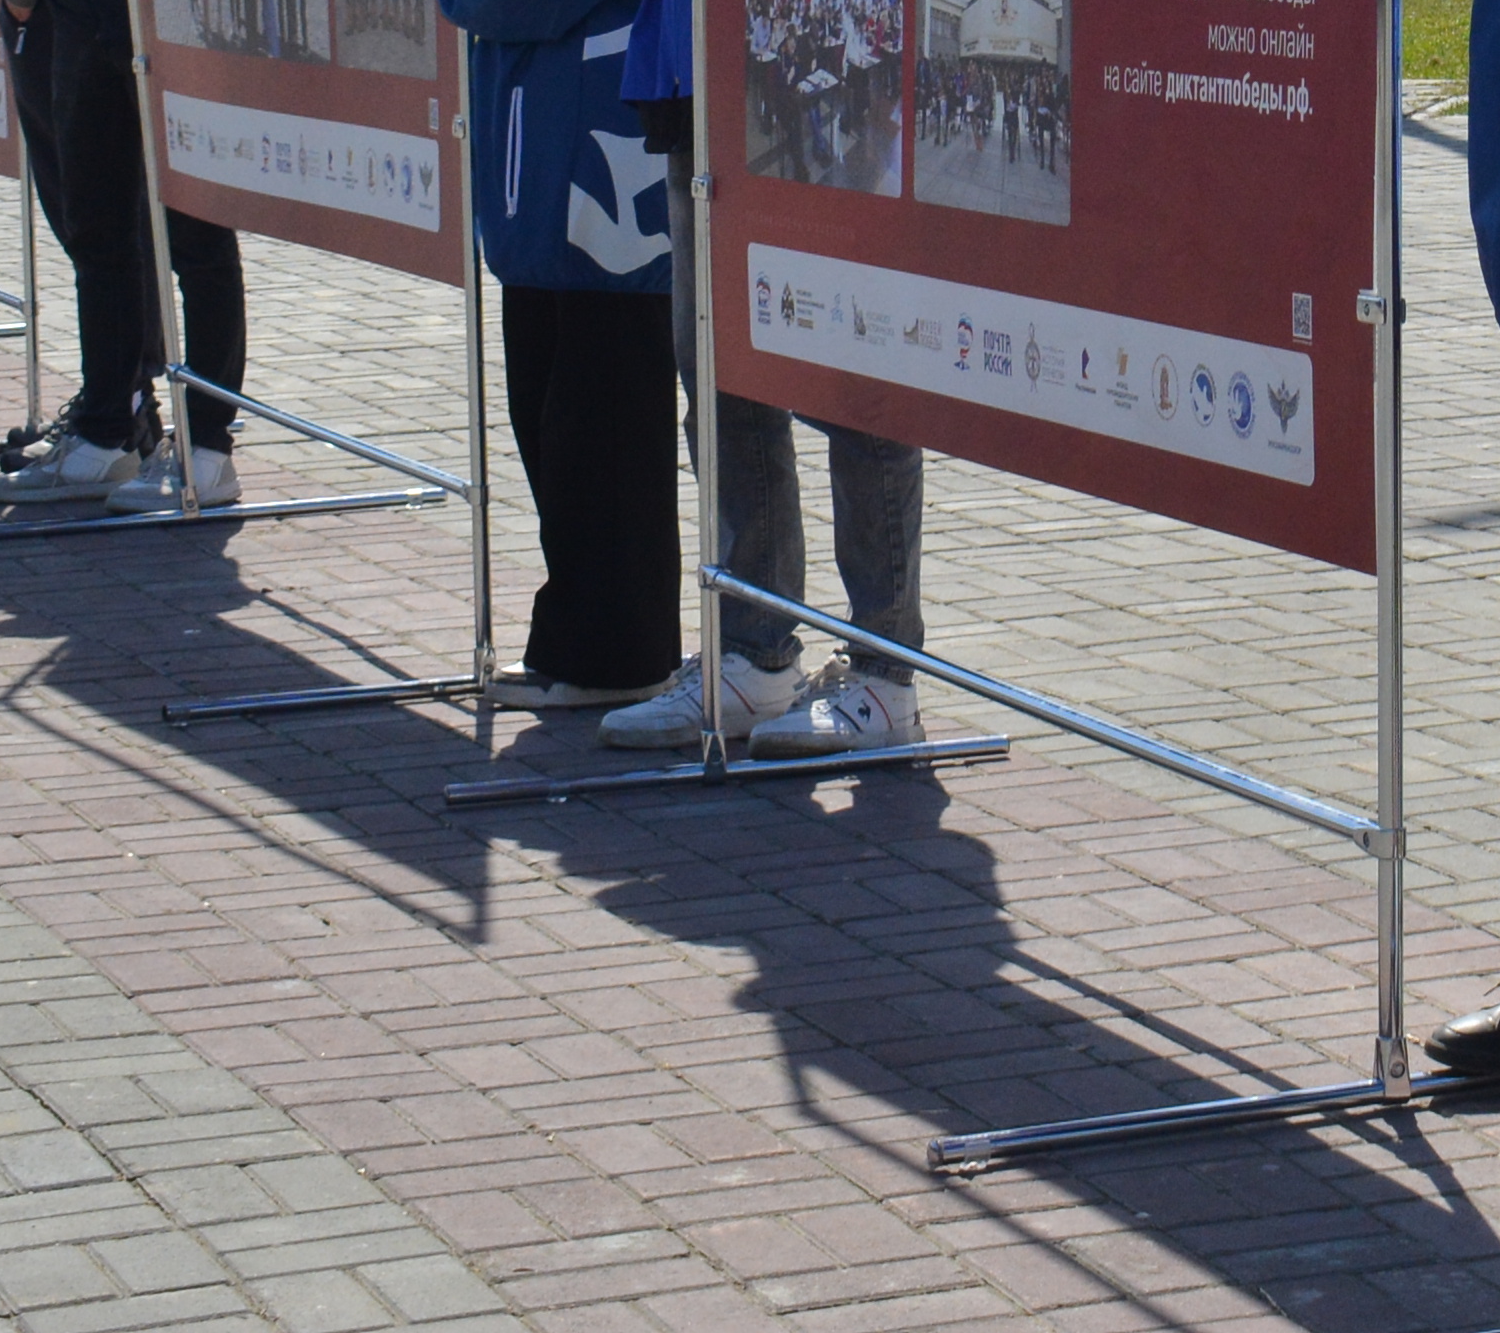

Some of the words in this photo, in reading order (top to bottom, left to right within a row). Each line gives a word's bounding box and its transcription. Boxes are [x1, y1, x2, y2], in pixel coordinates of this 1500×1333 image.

[1208, 24, 1254, 54] можно
[1260, 23, 1314, 60] онлайн
[1104, 65, 1119, 91] на
[1124, 61, 1162, 96] сайте
[1165, 72, 1312, 122] диктантпобеды.рф.
[983, 330, 1012, 354] ПОЧТА
[984, 352, 1013, 377] РОССИИ
